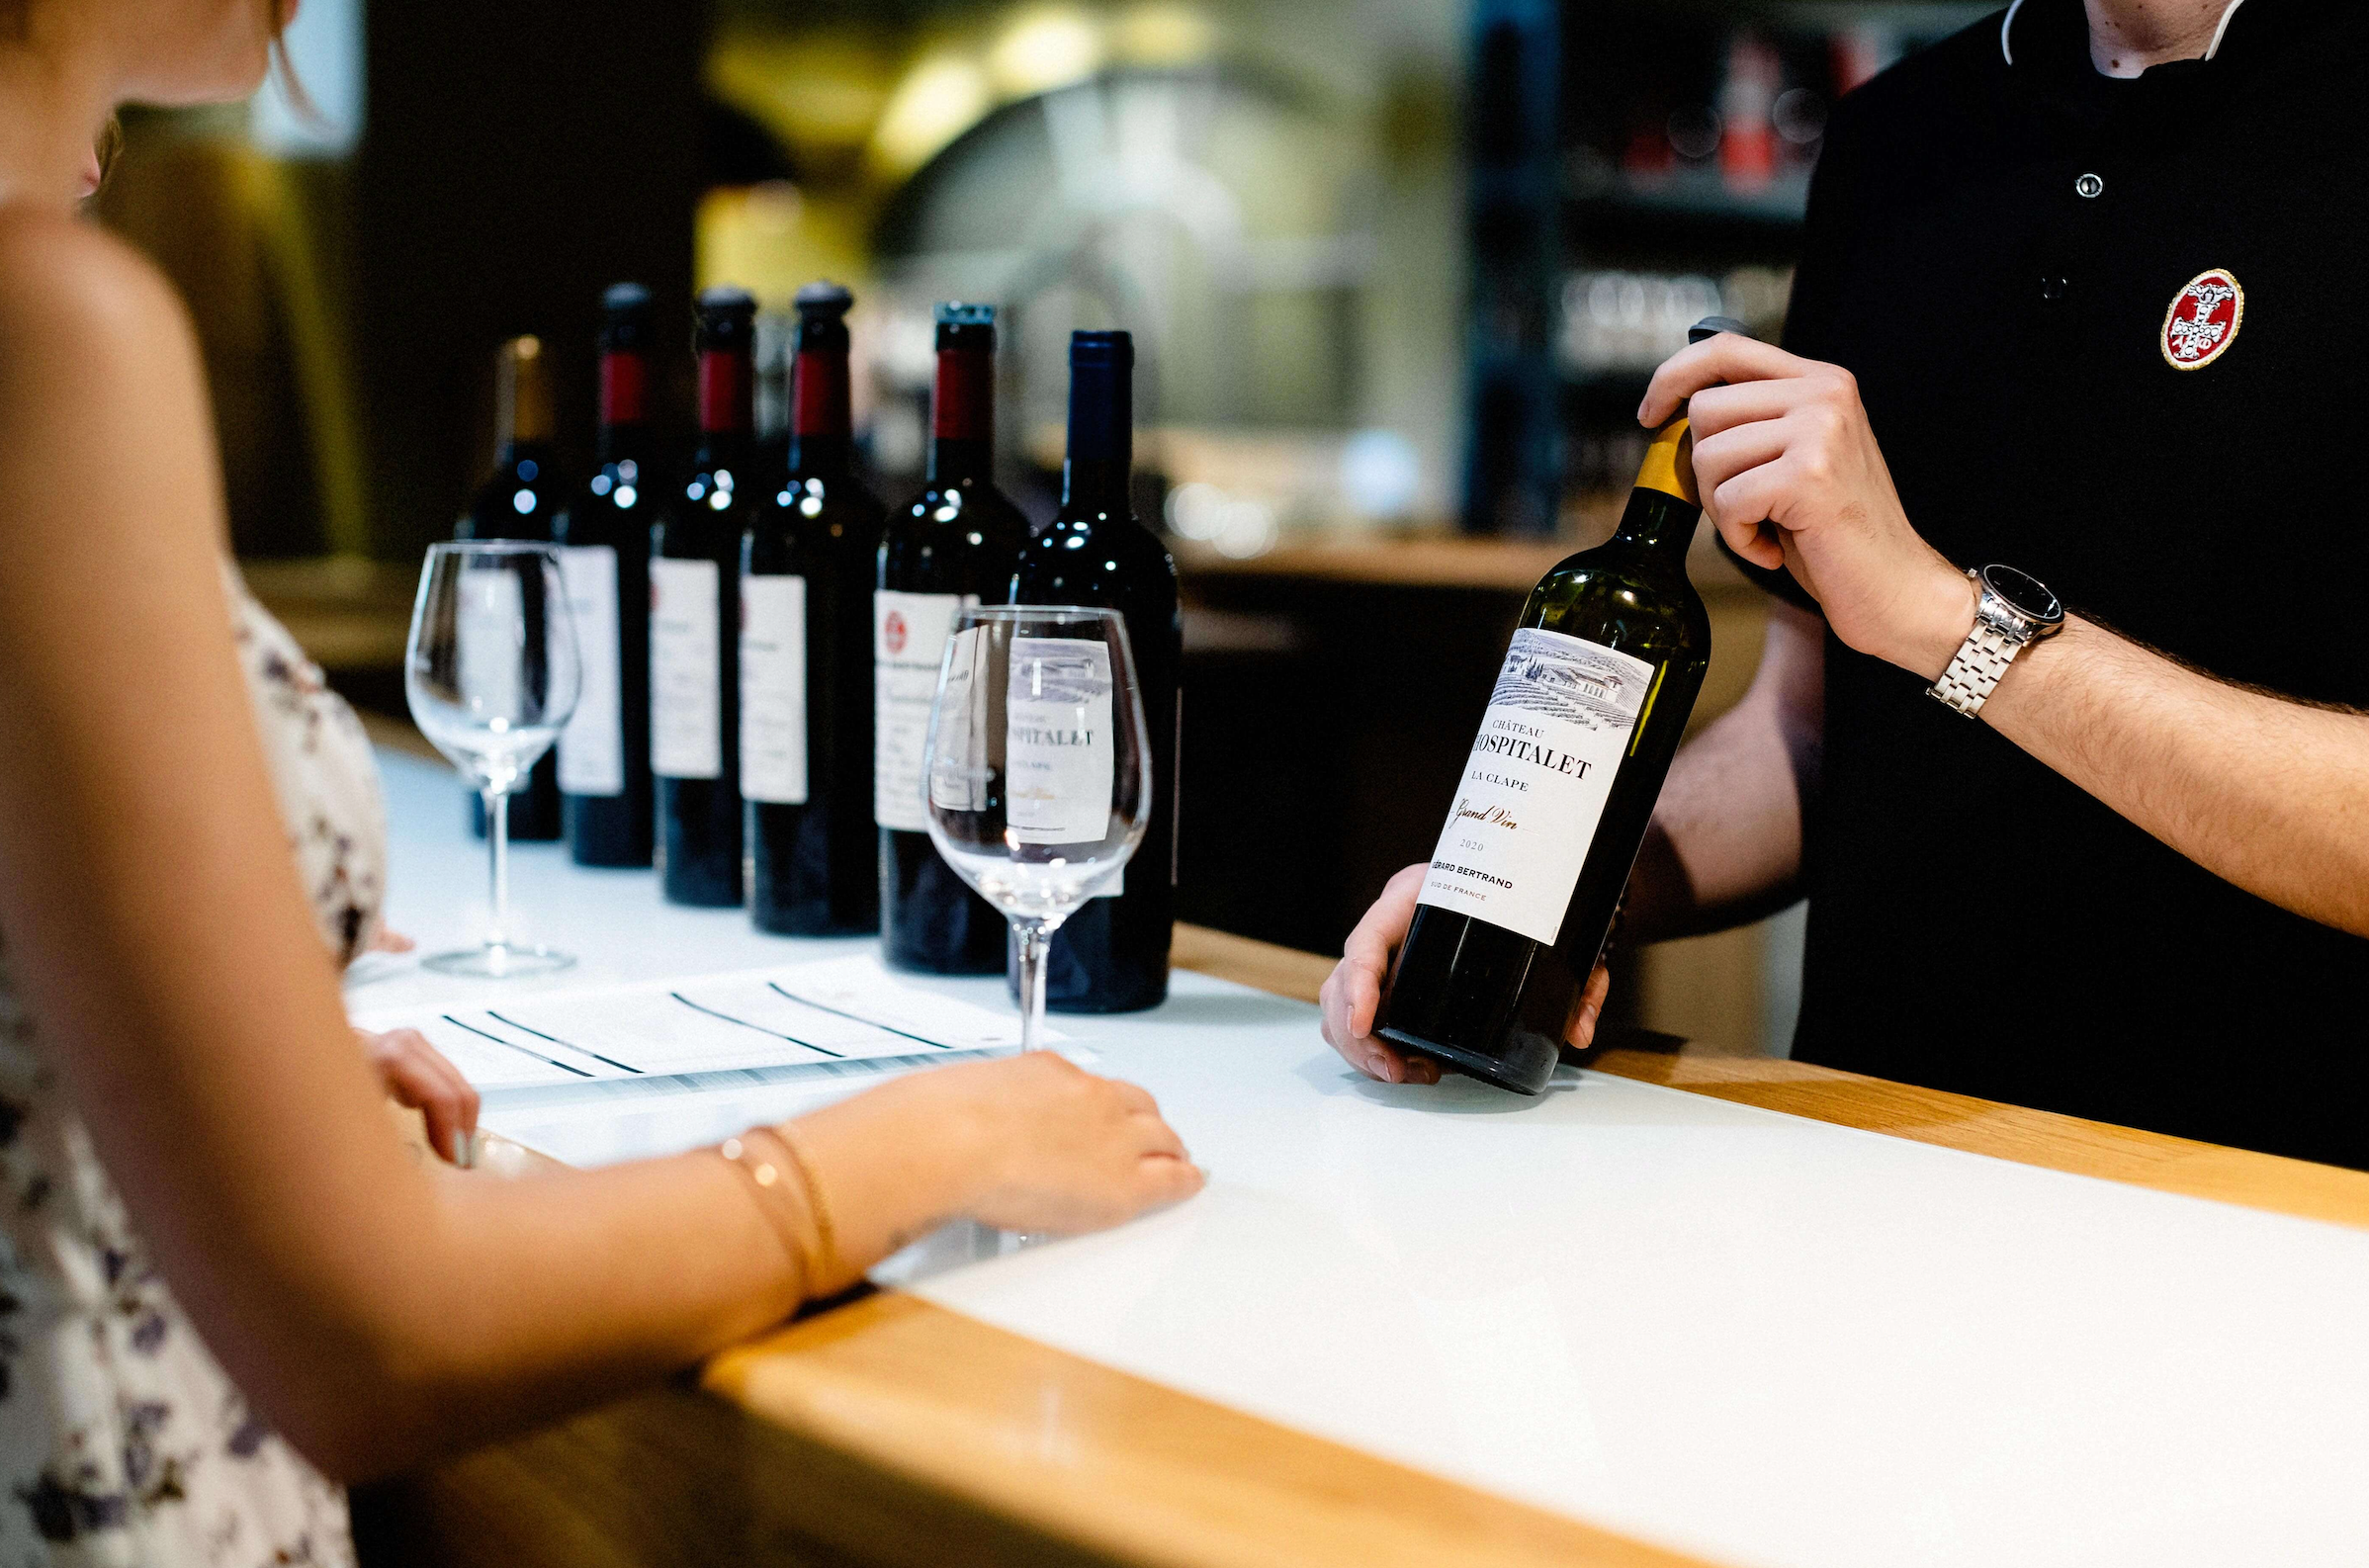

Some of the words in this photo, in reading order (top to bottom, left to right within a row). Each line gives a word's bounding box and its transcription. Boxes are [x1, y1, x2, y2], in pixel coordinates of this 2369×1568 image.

[1492, 719, 1544, 739] CHÂTEAU
[1471, 770, 1483, 781] LA
[1486, 772, 1530, 792] CLAPE
[1448, 798, 1495, 829] Grand
[1490, 807, 1518, 830] Vin
[1459, 838, 1484, 852] 2020
[1456, 866, 1513, 890] BERTRAND
[1453, 886, 1487, 902] FRANCE
